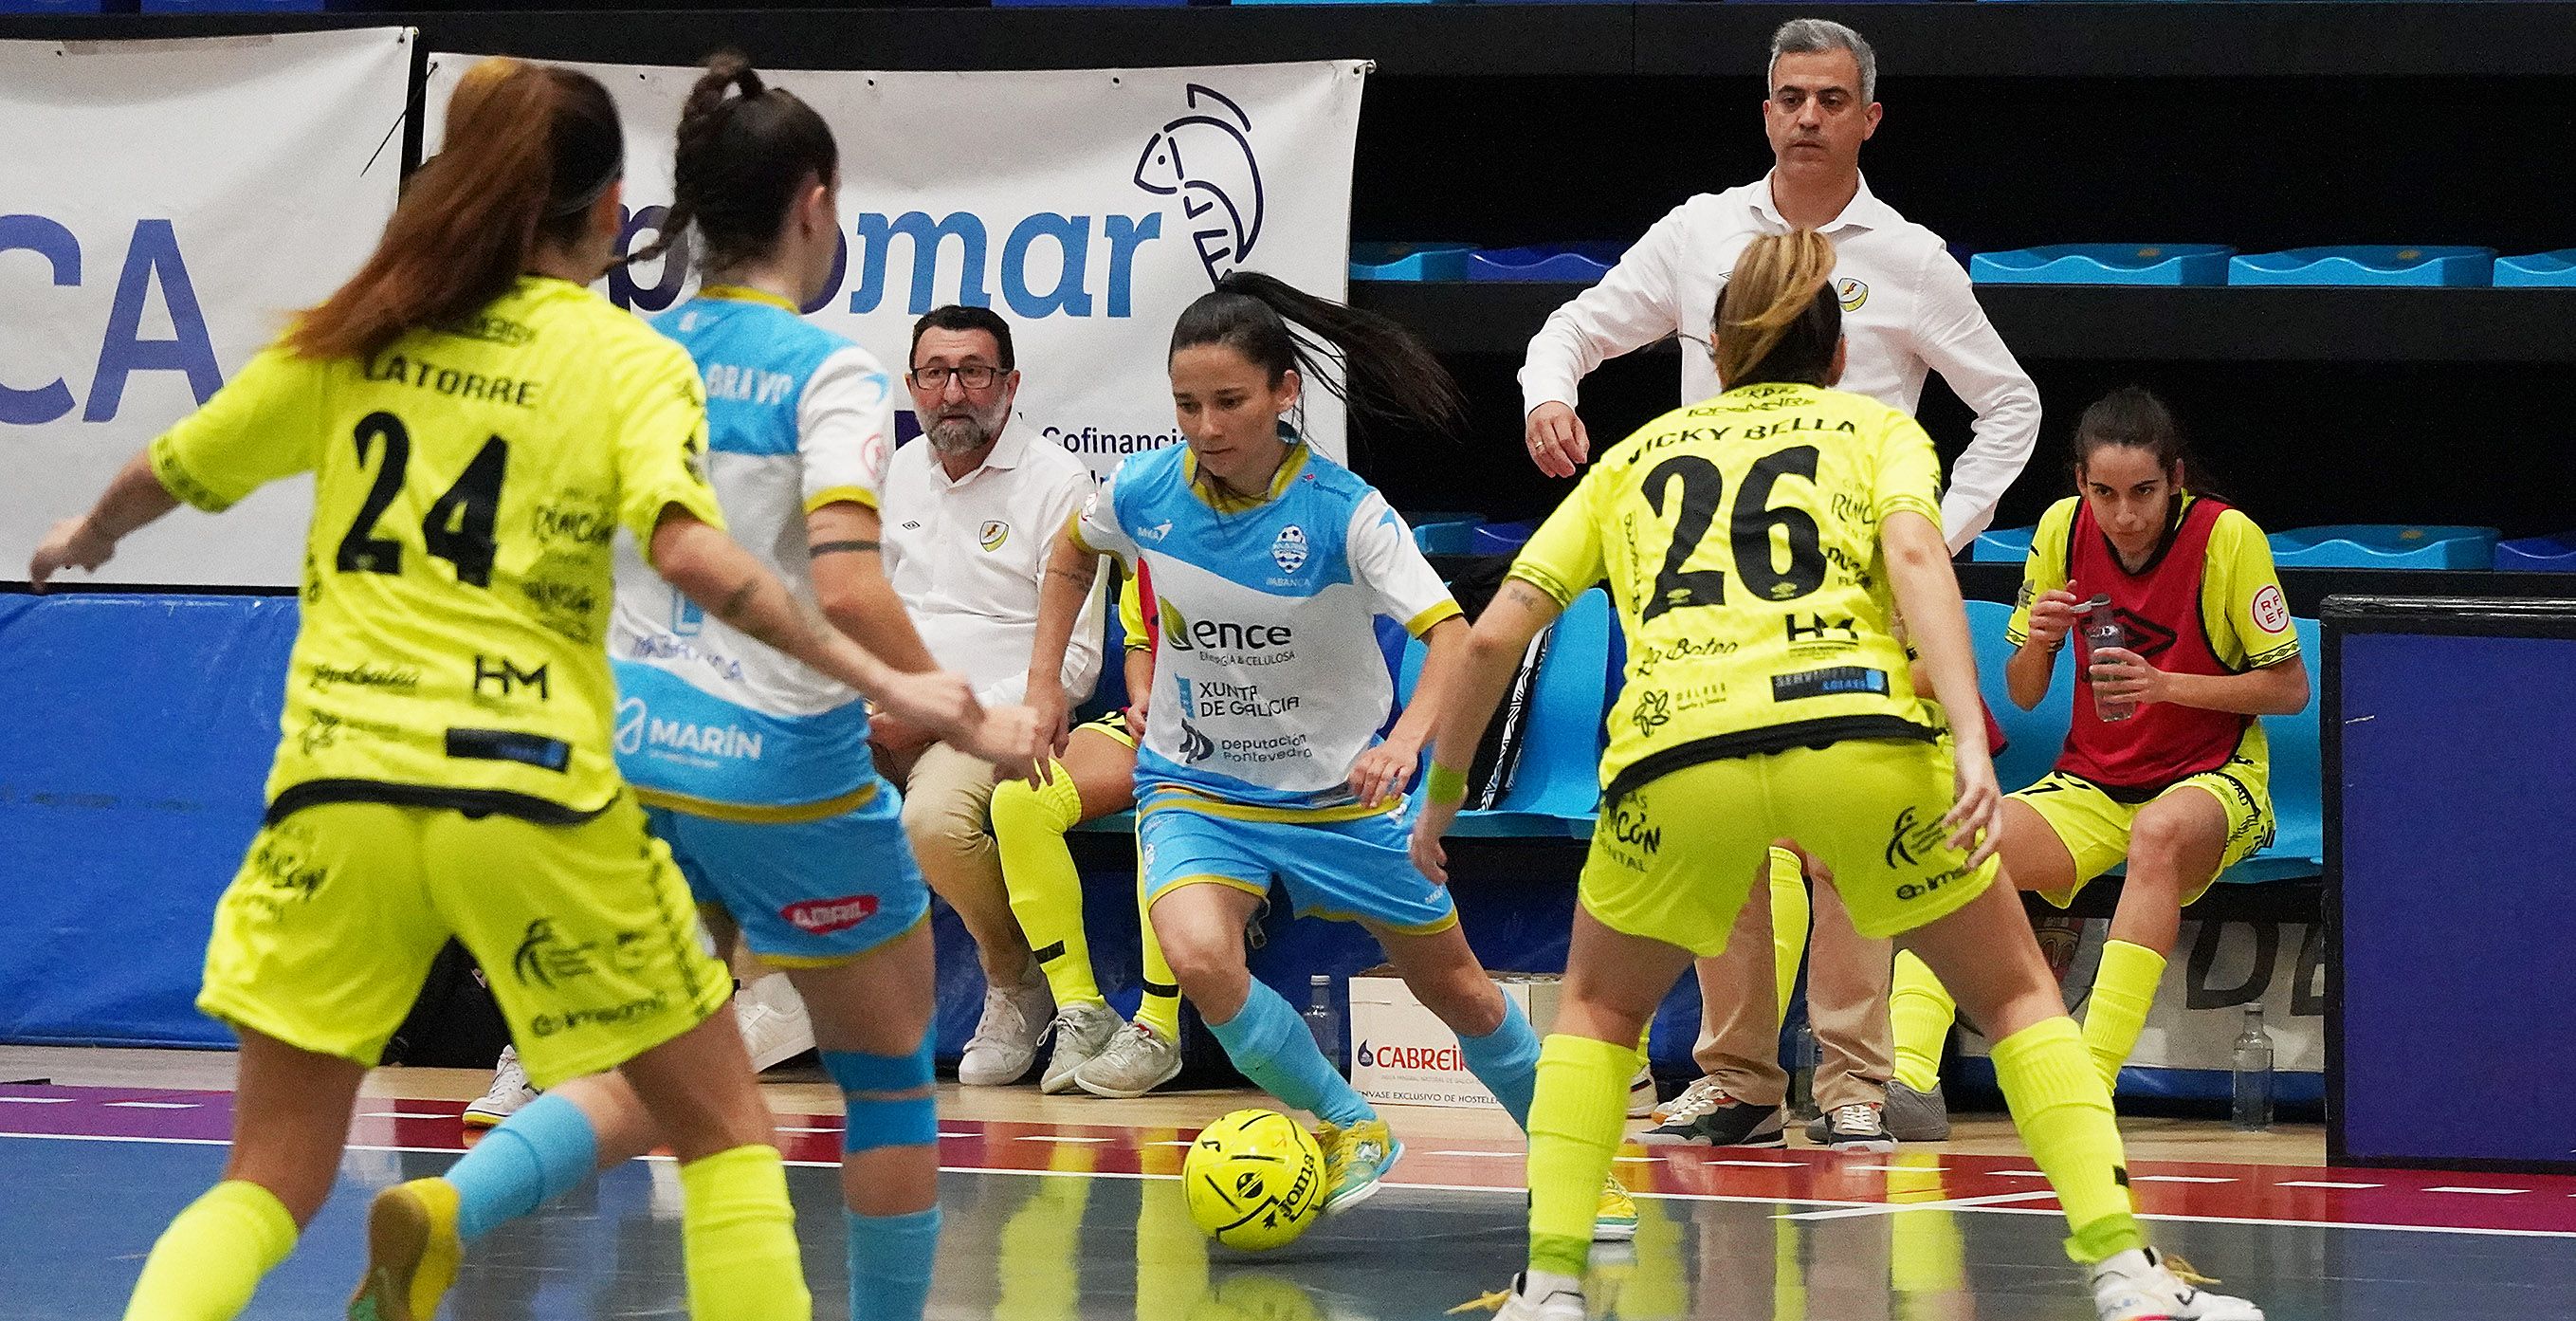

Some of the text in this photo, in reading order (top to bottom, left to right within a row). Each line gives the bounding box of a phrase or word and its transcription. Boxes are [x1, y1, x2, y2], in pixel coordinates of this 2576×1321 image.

[1627, 416, 1856, 466] VICKY BELLA
[336, 411, 509, 589] 24
[1640, 445, 1828, 626] 26
[1193, 620, 1292, 651] ence
[1247, 651, 1296, 667] CELULOSA
[474, 652, 549, 702] HM
[1199, 681, 1258, 702] XUNTA
[1200, 696, 1301, 718] DE GALICIA
[649, 718, 763, 761] MARÍN
[1221, 732, 1307, 752] Deputación
[1222, 746, 1314, 763] Pontevedra
[1393, 1092, 1442, 1102] EXCLUSIVO
[1444, 1093, 1455, 1103] DE
